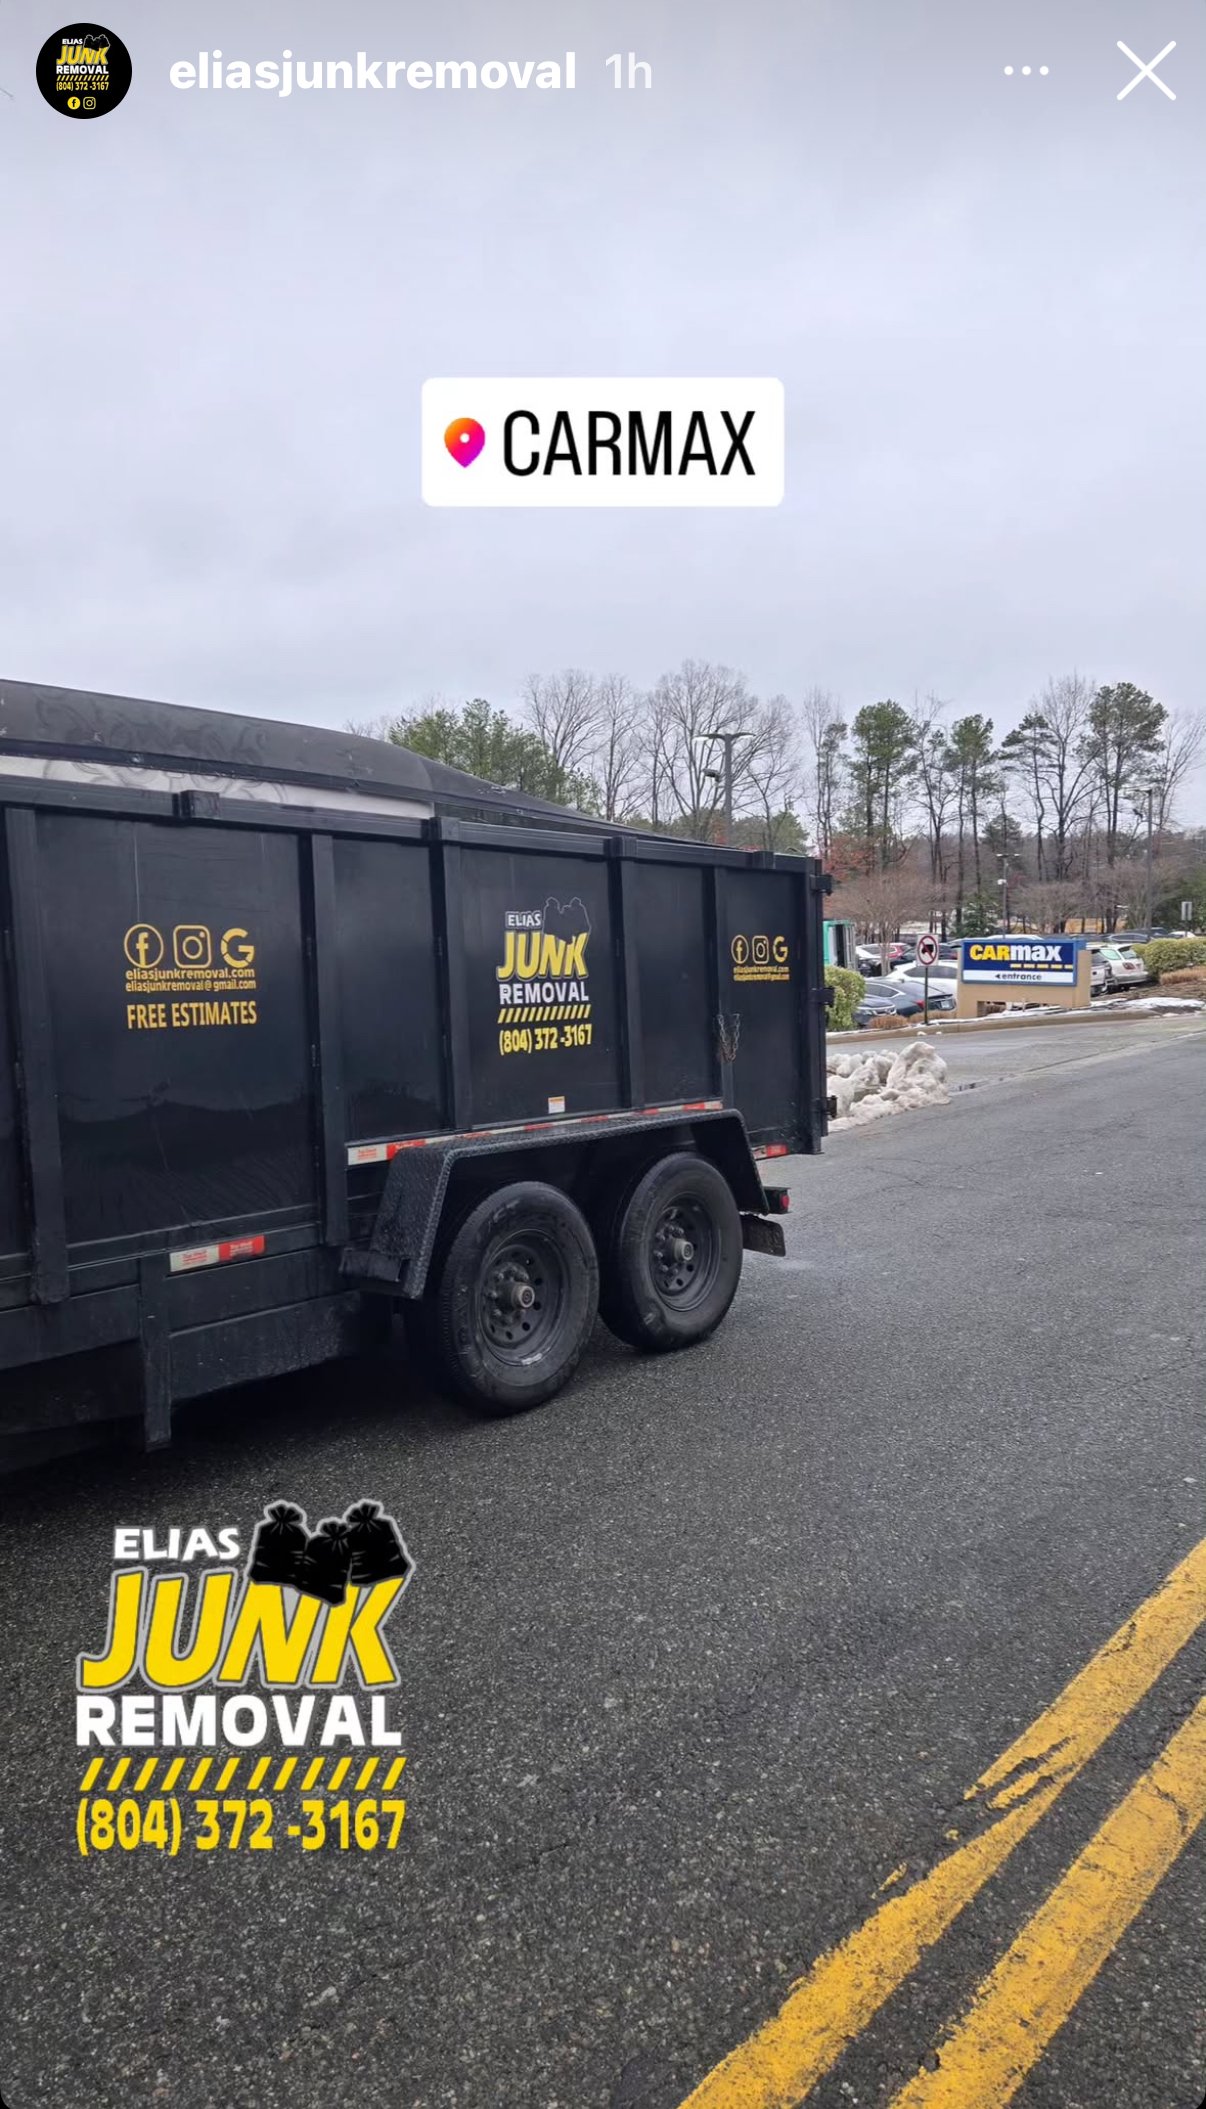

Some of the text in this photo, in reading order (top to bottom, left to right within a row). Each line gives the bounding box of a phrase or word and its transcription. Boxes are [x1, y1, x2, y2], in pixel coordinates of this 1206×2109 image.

[507, 913, 542, 927] ELIAS
[498, 931, 589, 980] JUNK
[125, 967, 255, 981] eliasjunkremoval.com
[1002, 972, 1042, 981] entrance
[499, 982, 589, 1005] REMOVAL
[127, 1001, 257, 1029] FREE ESTIMATES
[500, 1024, 592, 1056] (804) 372 -3167
